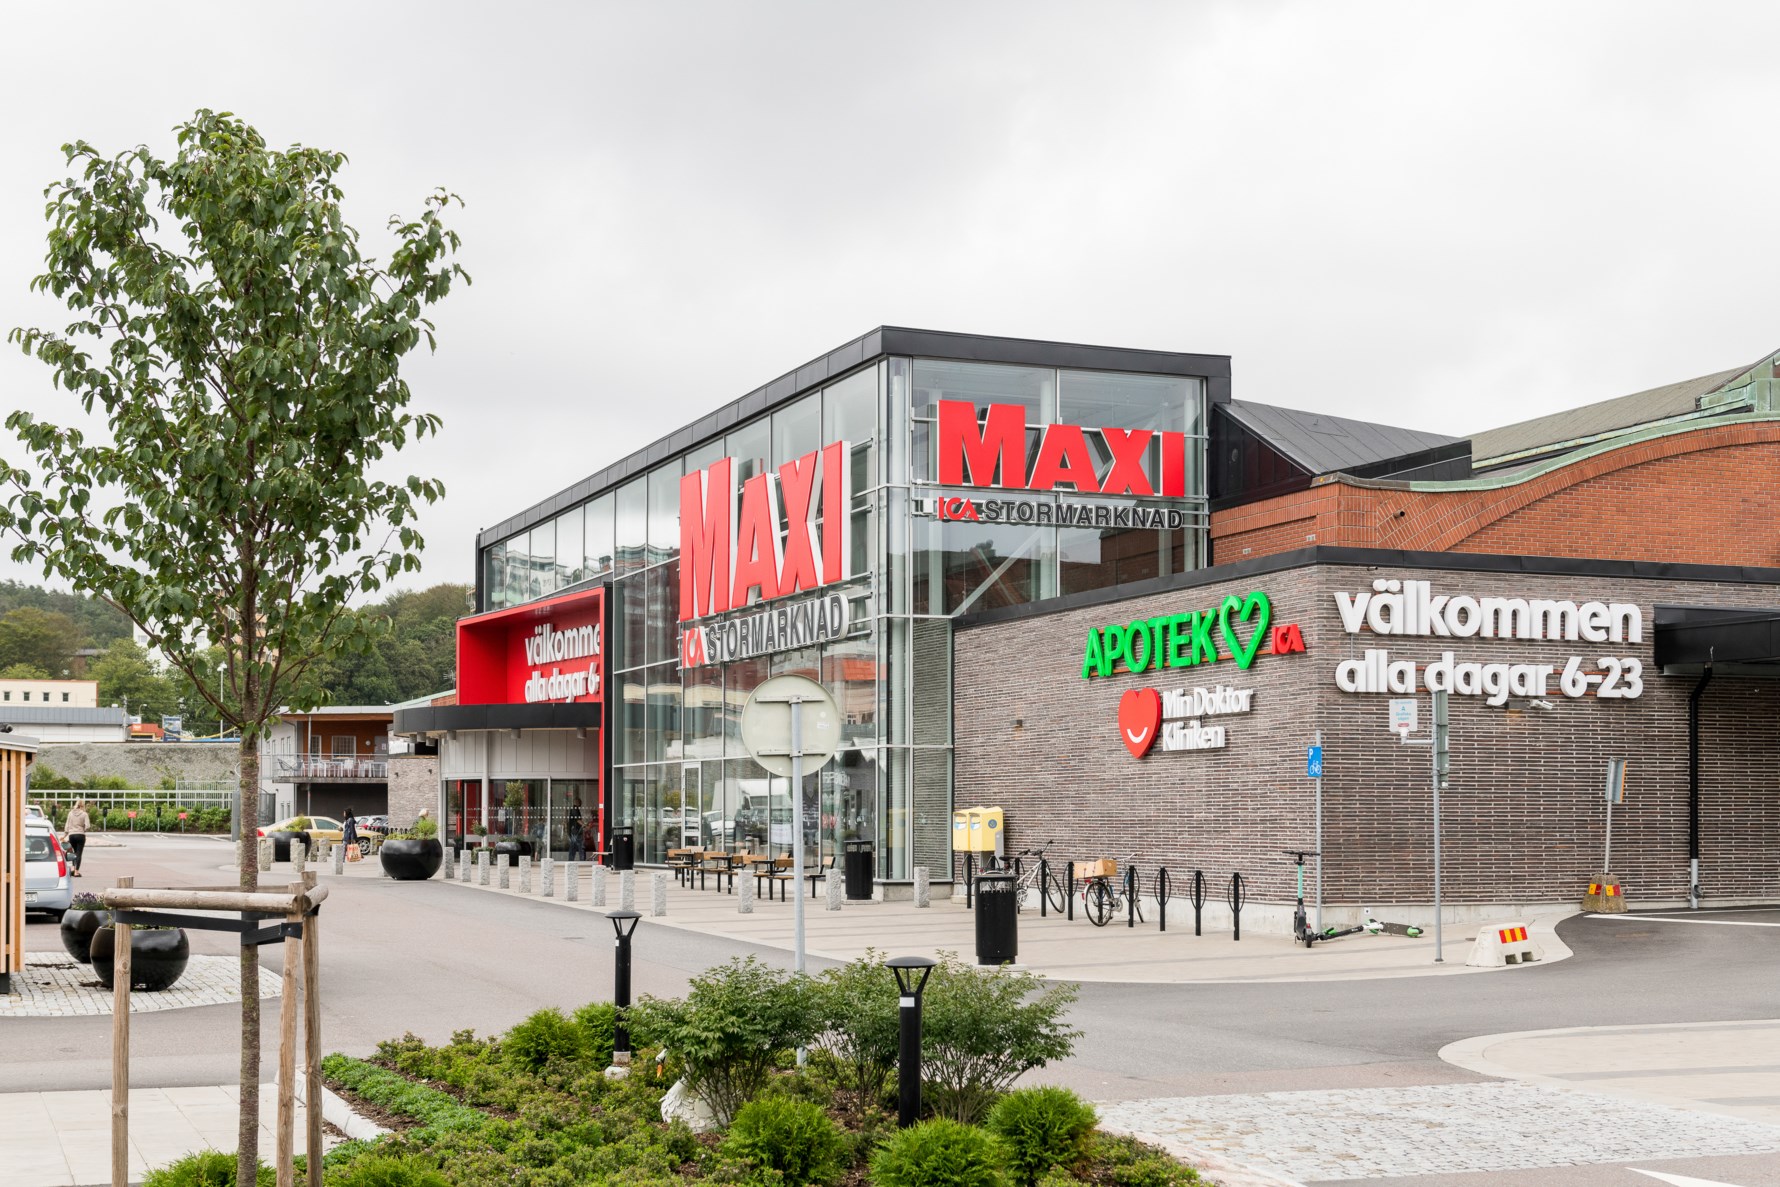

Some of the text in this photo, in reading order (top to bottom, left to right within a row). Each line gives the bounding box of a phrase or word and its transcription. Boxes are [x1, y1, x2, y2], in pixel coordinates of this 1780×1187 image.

[937, 400, 1185, 497] MAXI
[680, 440, 851, 622] MAXI
[938, 496, 1185, 530] ICA STORMARKNAD
[682, 593, 849, 669] ICA STORMARKNAD
[1334, 580, 1642, 642] välkommen
[1081, 608, 1305, 679] APOTEK ICA
[525, 671, 549, 703] alla
[548, 667, 588, 703] dagar
[1335, 649, 1644, 707] alla dagar 6-23
[1162, 720, 1225, 752] Kliniken
[1309, 748, 1314, 760] P
